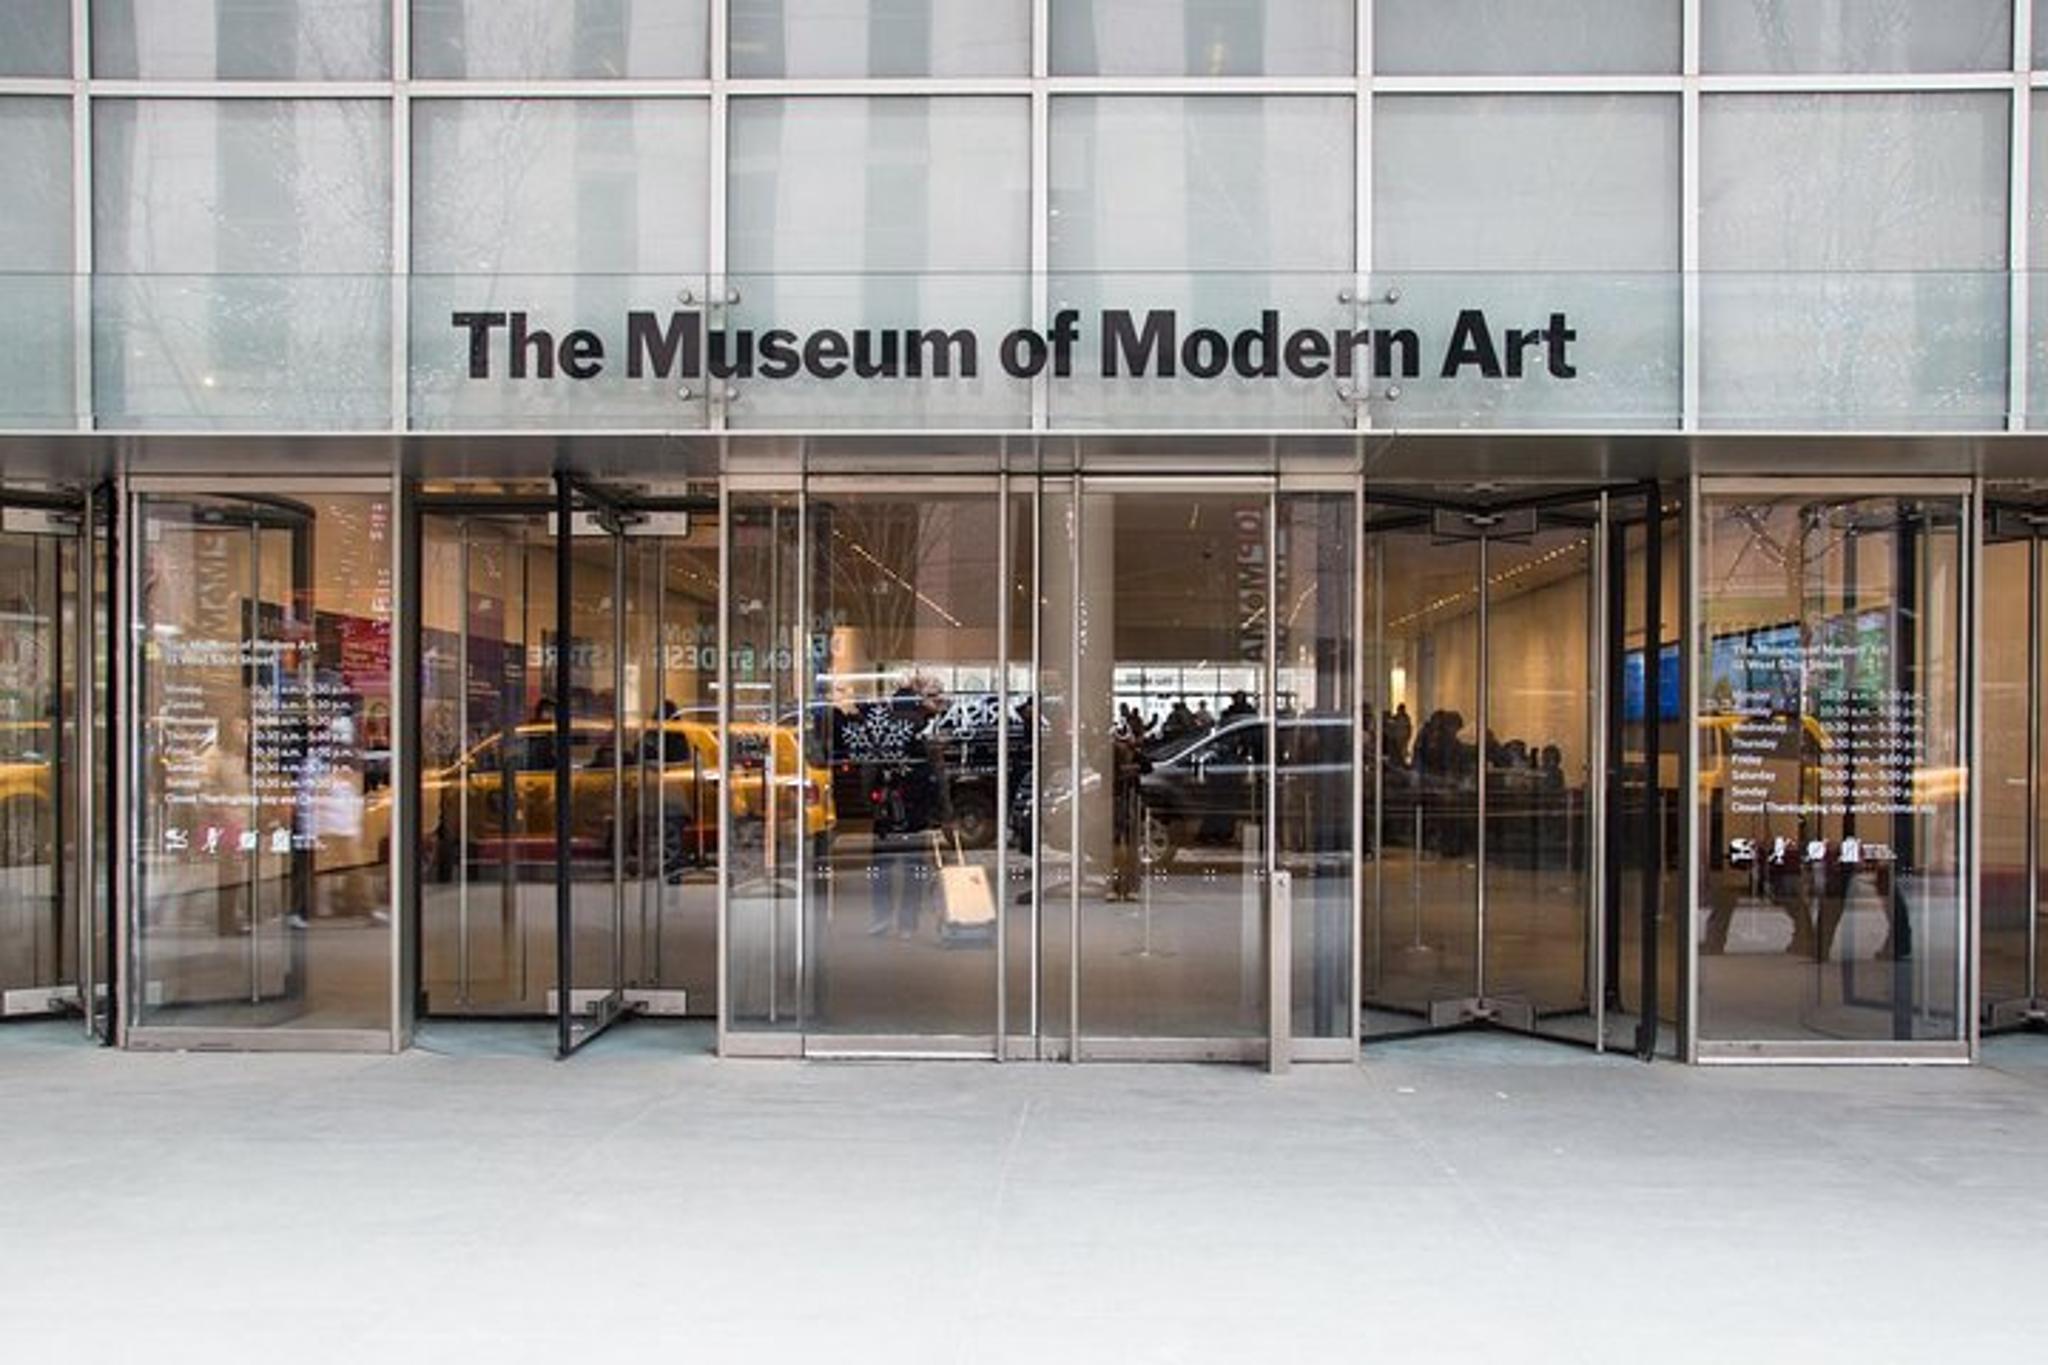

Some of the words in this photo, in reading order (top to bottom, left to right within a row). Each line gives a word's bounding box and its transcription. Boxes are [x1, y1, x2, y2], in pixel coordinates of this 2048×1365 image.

[452, 311, 604, 379] The
[627, 311, 978, 379] Museum
[1000, 310, 1079, 378] of
[1101, 310, 1420, 378] Modern
[1440, 310, 1576, 378] Art
[299, 639, 317, 650] Art
[1732, 771, 1776, 782] Saturday
[1732, 787, 1768, 798] Sunday
